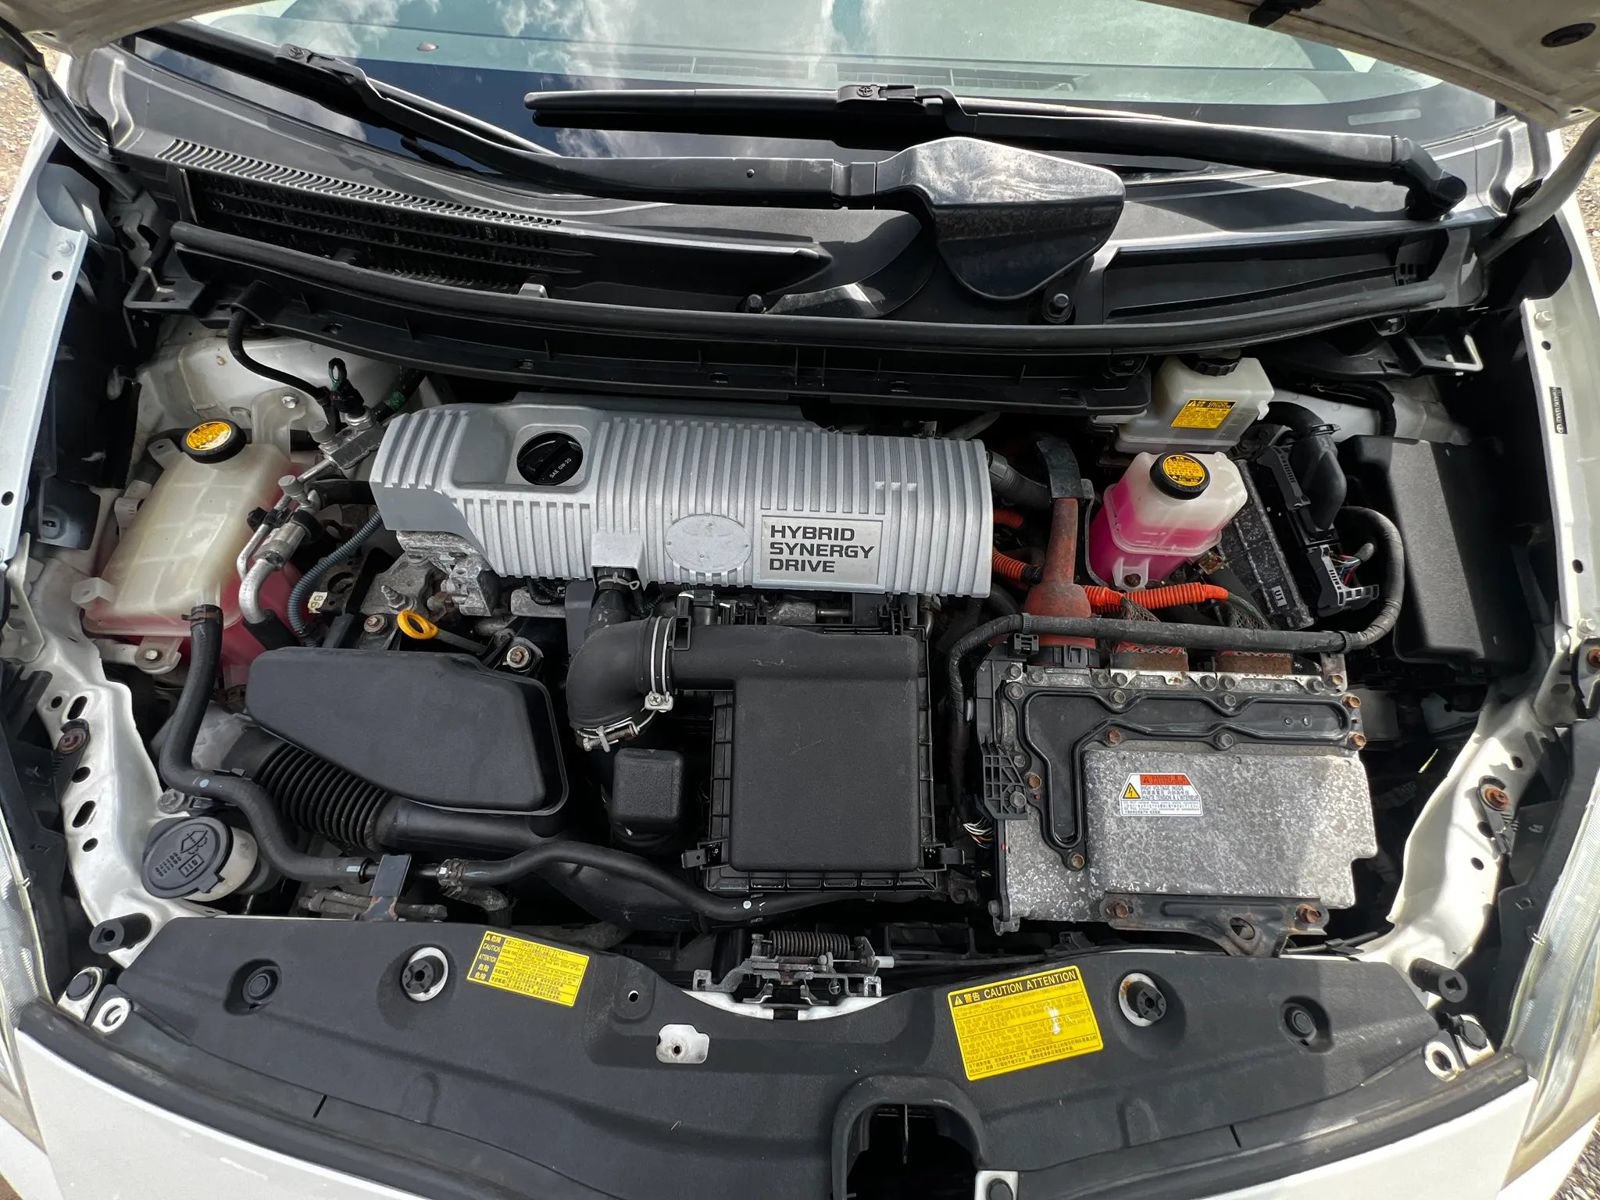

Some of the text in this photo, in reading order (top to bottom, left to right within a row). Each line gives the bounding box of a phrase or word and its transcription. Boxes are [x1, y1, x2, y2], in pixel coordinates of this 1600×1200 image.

[771, 525, 854, 541] HYBRID
[770, 542, 874, 558] SYNERGY
[769, 558, 835, 573] DRIVE
[983, 982, 1023, 999] CAUTION
[1027, 970, 1077, 990] ATTENTION
